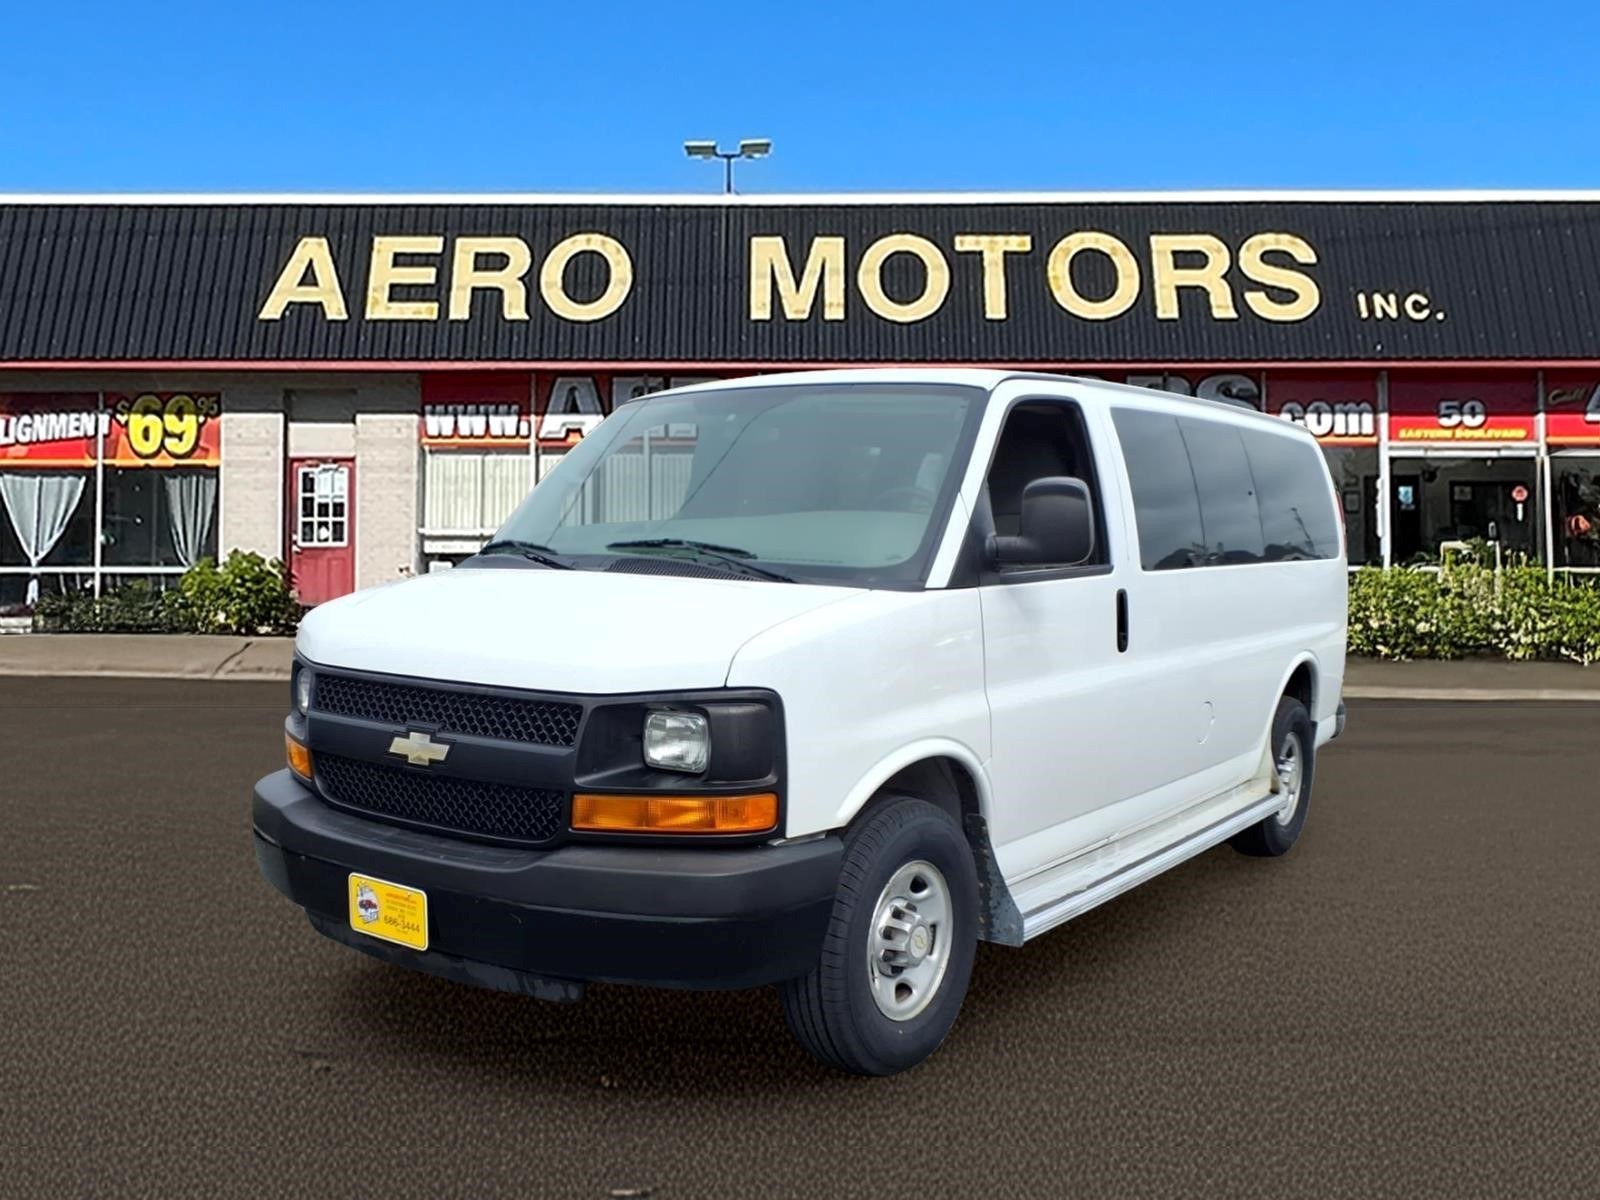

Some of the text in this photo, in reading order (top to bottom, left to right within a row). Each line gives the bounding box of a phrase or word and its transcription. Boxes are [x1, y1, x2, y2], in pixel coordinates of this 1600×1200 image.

[258, 232, 1445, 322] AERO MOTORS INC.
[1437, 401, 1486, 427] 50
